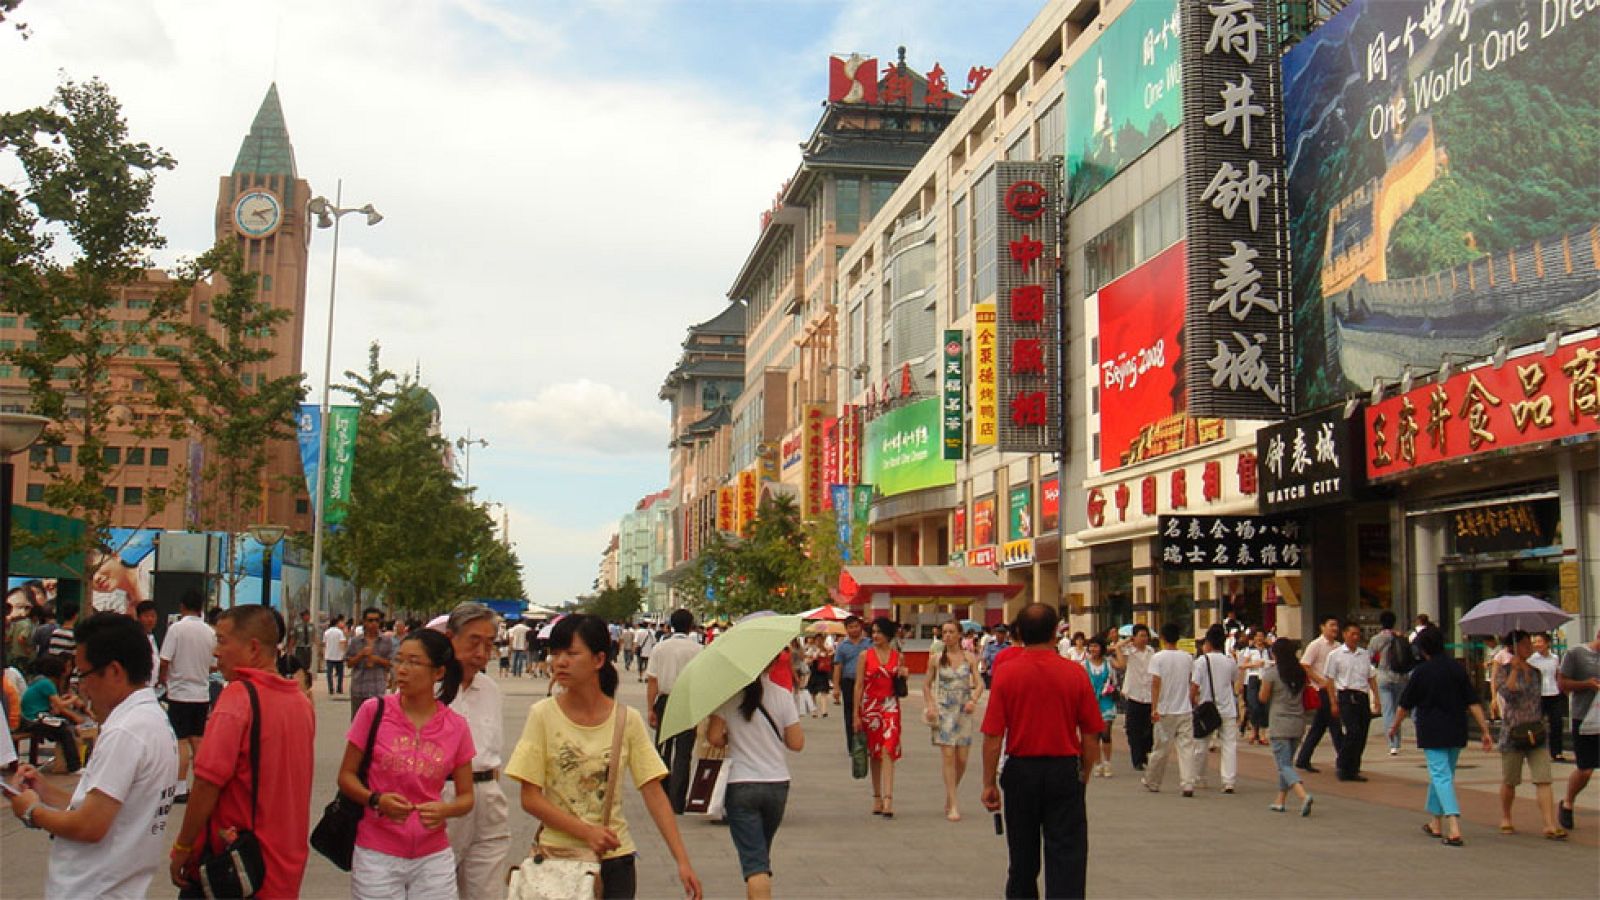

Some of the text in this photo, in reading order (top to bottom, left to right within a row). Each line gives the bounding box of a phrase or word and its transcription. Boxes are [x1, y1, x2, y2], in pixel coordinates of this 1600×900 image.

[1369, 96, 1408, 140] One
[1413, 44, 1473, 114] World
[1482, 20, 1530, 71] One
[1101, 352, 1137, 391] Beijing
[1265, 422, 1339, 479] 钟表城
[1267, 478, 1340, 504] WATCH CITY
